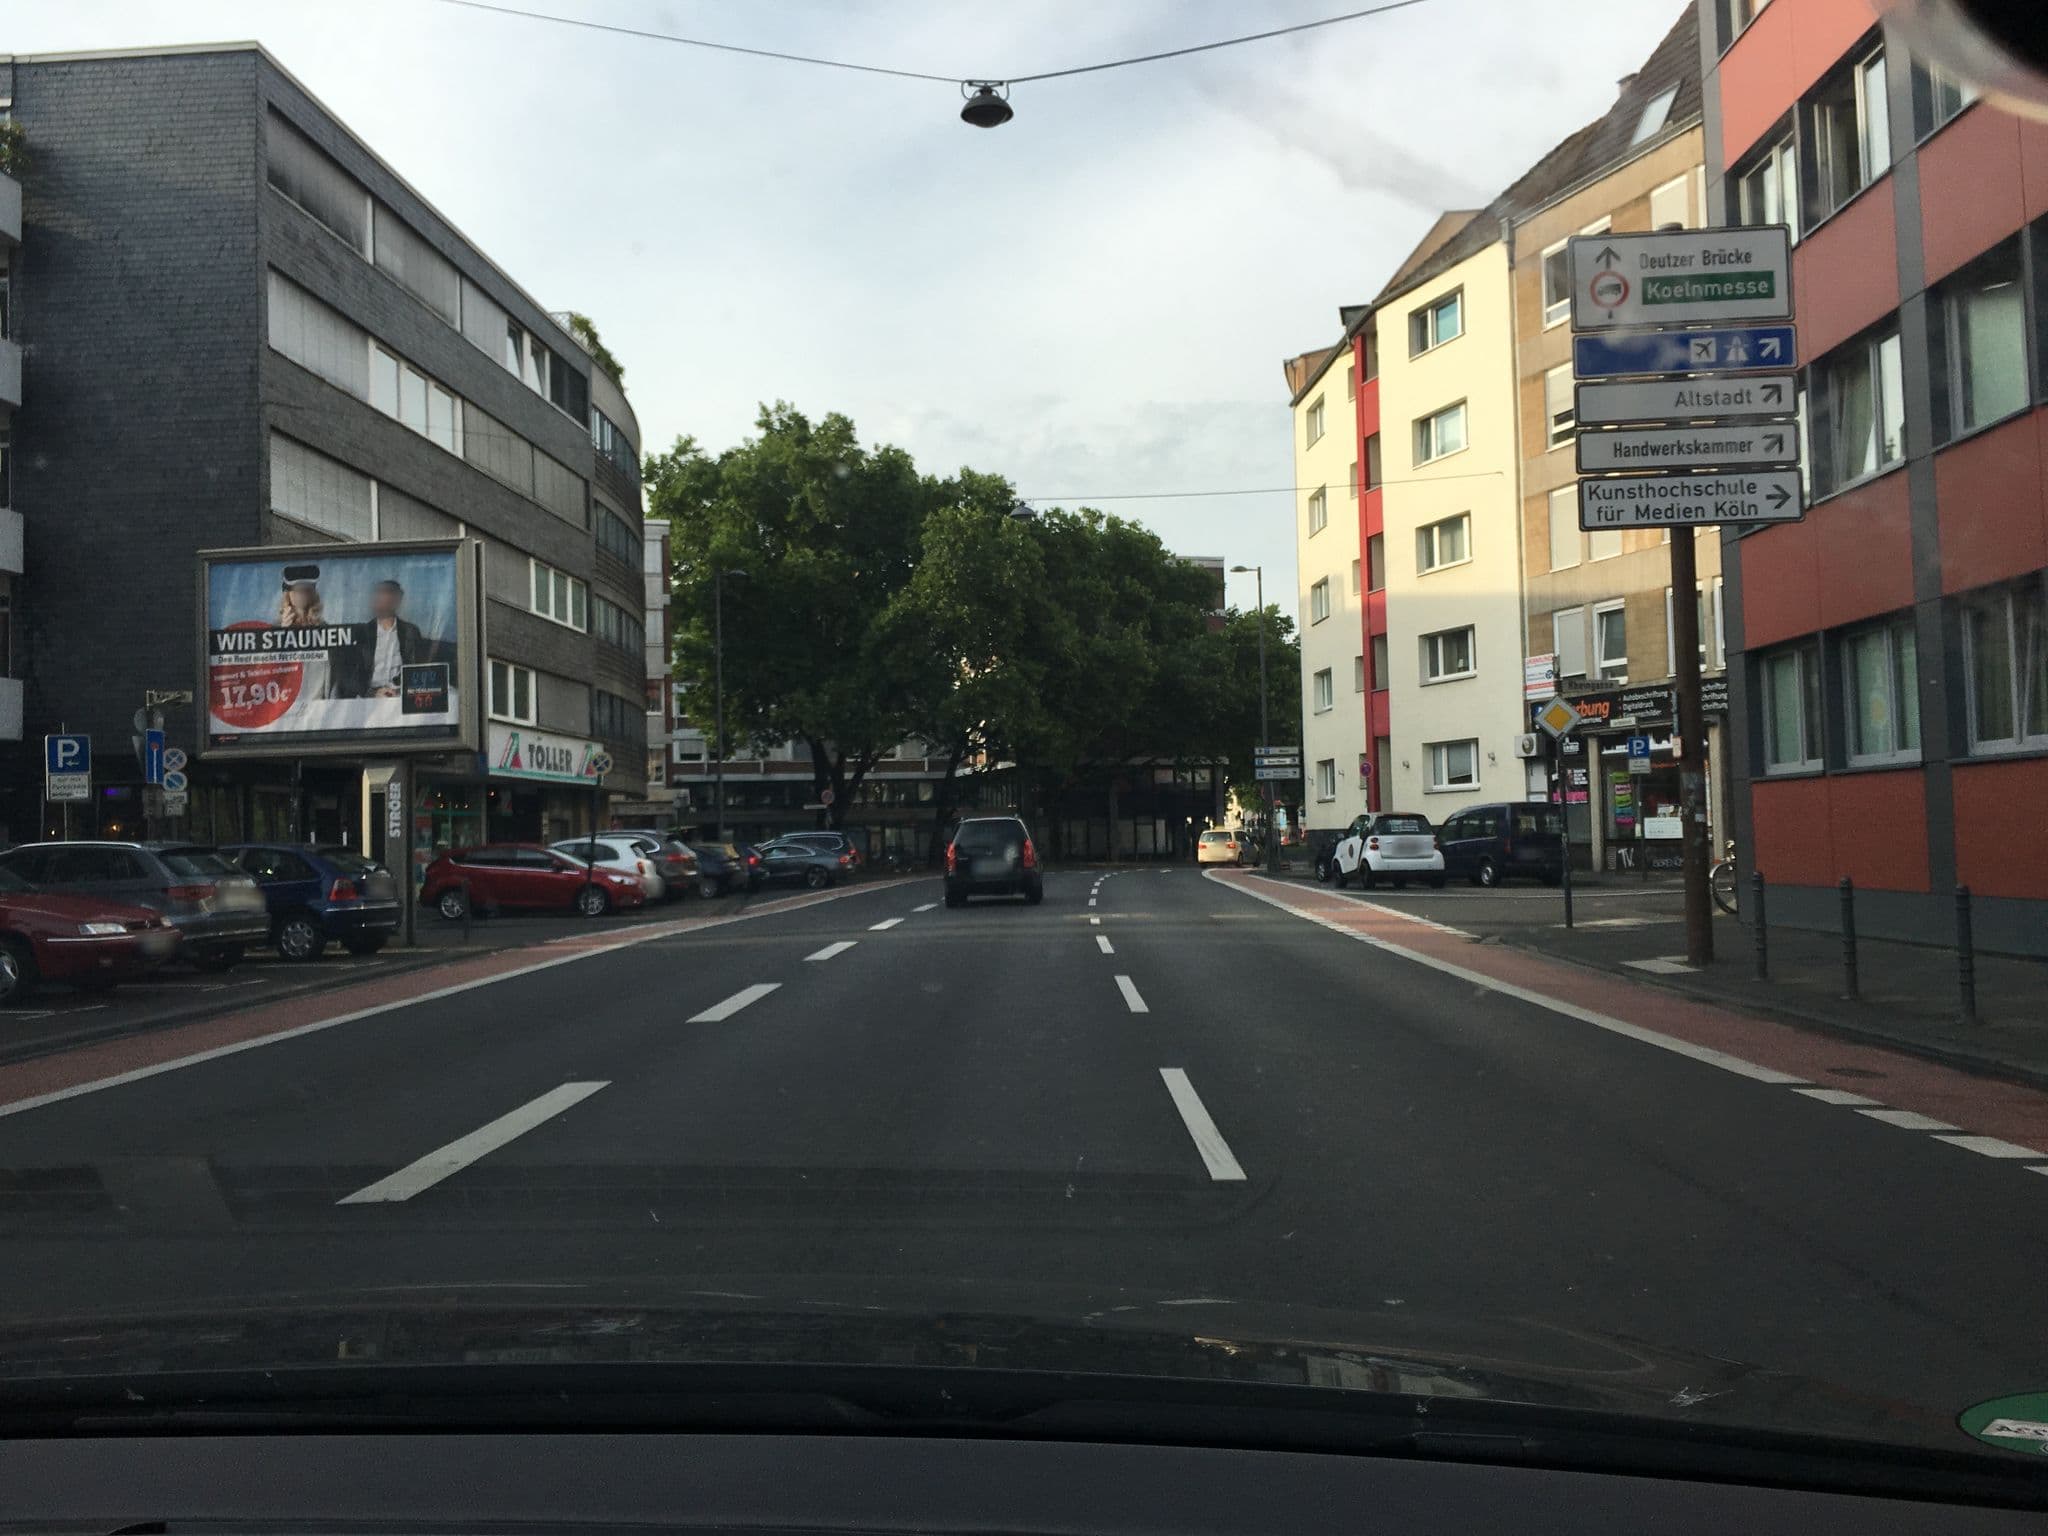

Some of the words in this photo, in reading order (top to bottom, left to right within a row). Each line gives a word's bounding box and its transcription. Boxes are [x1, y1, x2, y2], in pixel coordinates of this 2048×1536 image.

[1639, 252, 1696, 270] Deutzer
[1702, 248, 1753, 267] Brücke
[1646, 279, 1769, 300] Koelnmesse
[1674, 389, 1753, 409] Altstadt
[1613, 438, 1754, 459] Handwerkskammer
[1588, 478, 1757, 501] Kunsthochschule
[1596, 505, 1625, 523] für
[1635, 503, 1706, 522] Medien
[1714, 500, 1759, 519] Köln
[217, 630, 256, 652] WIR
[262, 626, 357, 650] STAUNEN.
[1573, 700, 1610, 718] rbung
